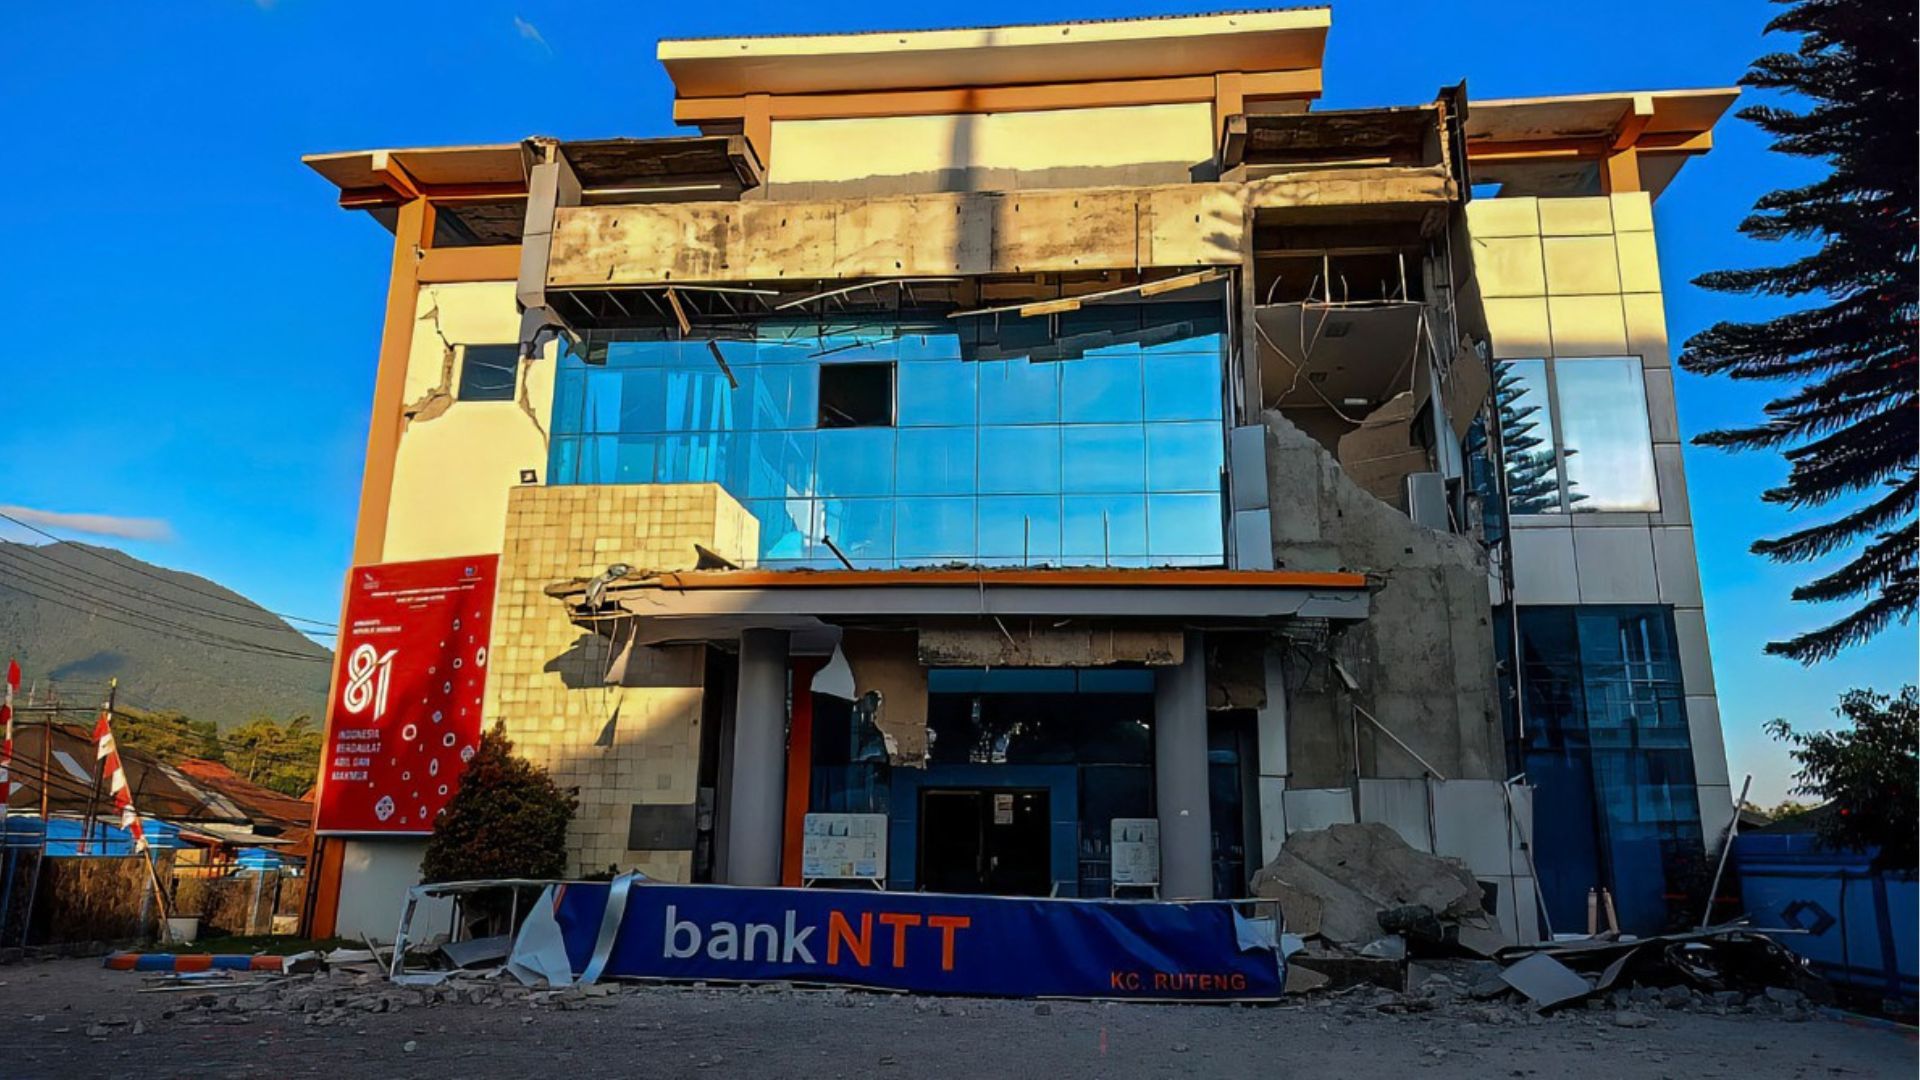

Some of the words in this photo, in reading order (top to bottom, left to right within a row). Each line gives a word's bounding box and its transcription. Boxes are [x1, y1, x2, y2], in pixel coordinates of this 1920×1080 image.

[343, 643, 398, 722] 81
[338, 728, 380, 740] INDONESIA
[1111, 971, 1146, 991] KC.
[1155, 973, 1246, 992] RUTENG
